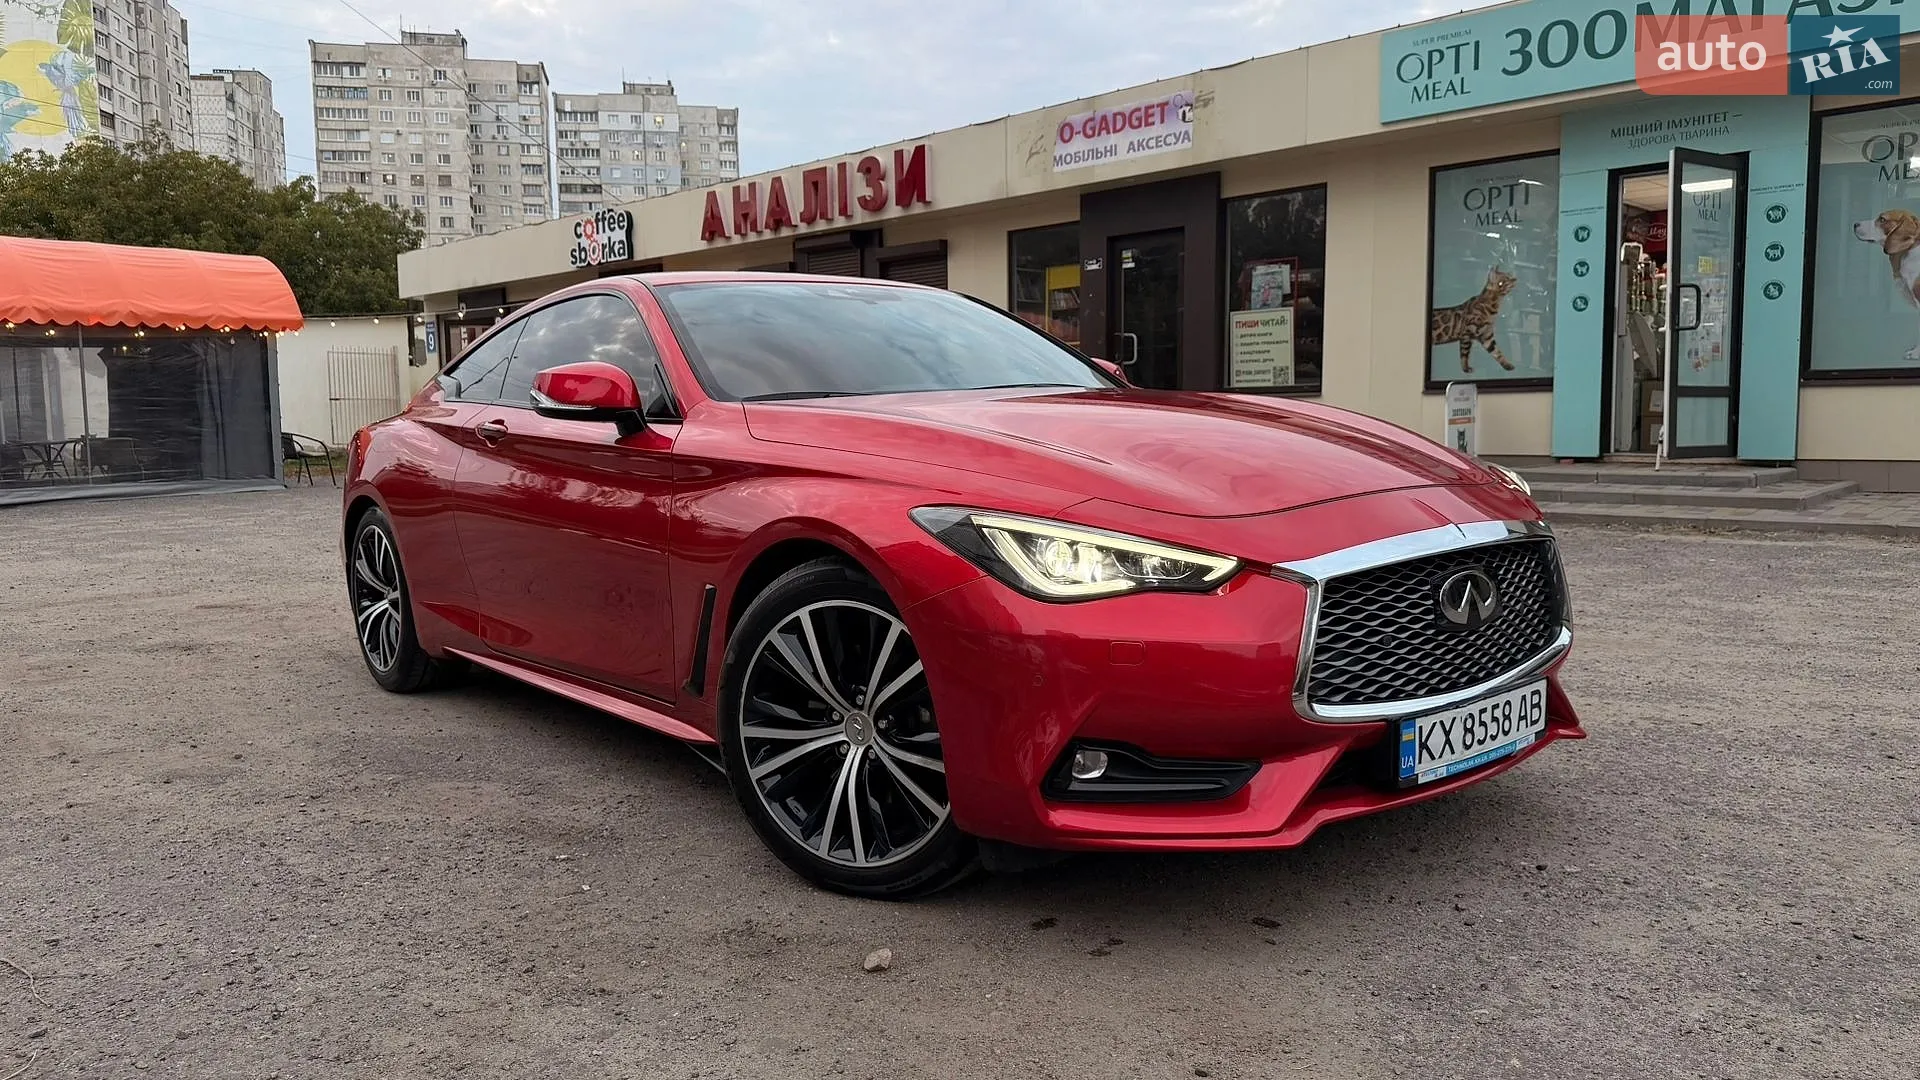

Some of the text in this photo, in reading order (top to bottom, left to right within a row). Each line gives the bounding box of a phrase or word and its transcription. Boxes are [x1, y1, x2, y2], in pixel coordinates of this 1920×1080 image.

[1501, 0, 1904, 76] ЗООМА
[1396, 40, 1480, 83] OPTI
[1411, 77, 1472, 104] MEAL
[1059, 100, 1169, 144] O-GADGET
[1610, 119, 1663, 138] МІЦНИЙ
[1667, 111, 1729, 130] ІМУНІТЕТ
[1053, 130, 1192, 168] МОБІЛЬНІ АКСЕСУА
[1628, 126, 1730, 149] ЗДОРОВА ТВАРИНА
[1878, 161, 1920, 182] ME
[701, 144, 930, 241] АНАЛІЗИ
[1463, 183, 1530, 211] OPTI
[574, 210, 626, 239] coffee
[1475, 209, 1523, 227] MEAL
[570, 236, 626, 265] sborka
[428, 333, 435, 350] 9
[1418, 689, 1542, 765] KX 8558 AB
[1401, 755, 1414, 768] UA
